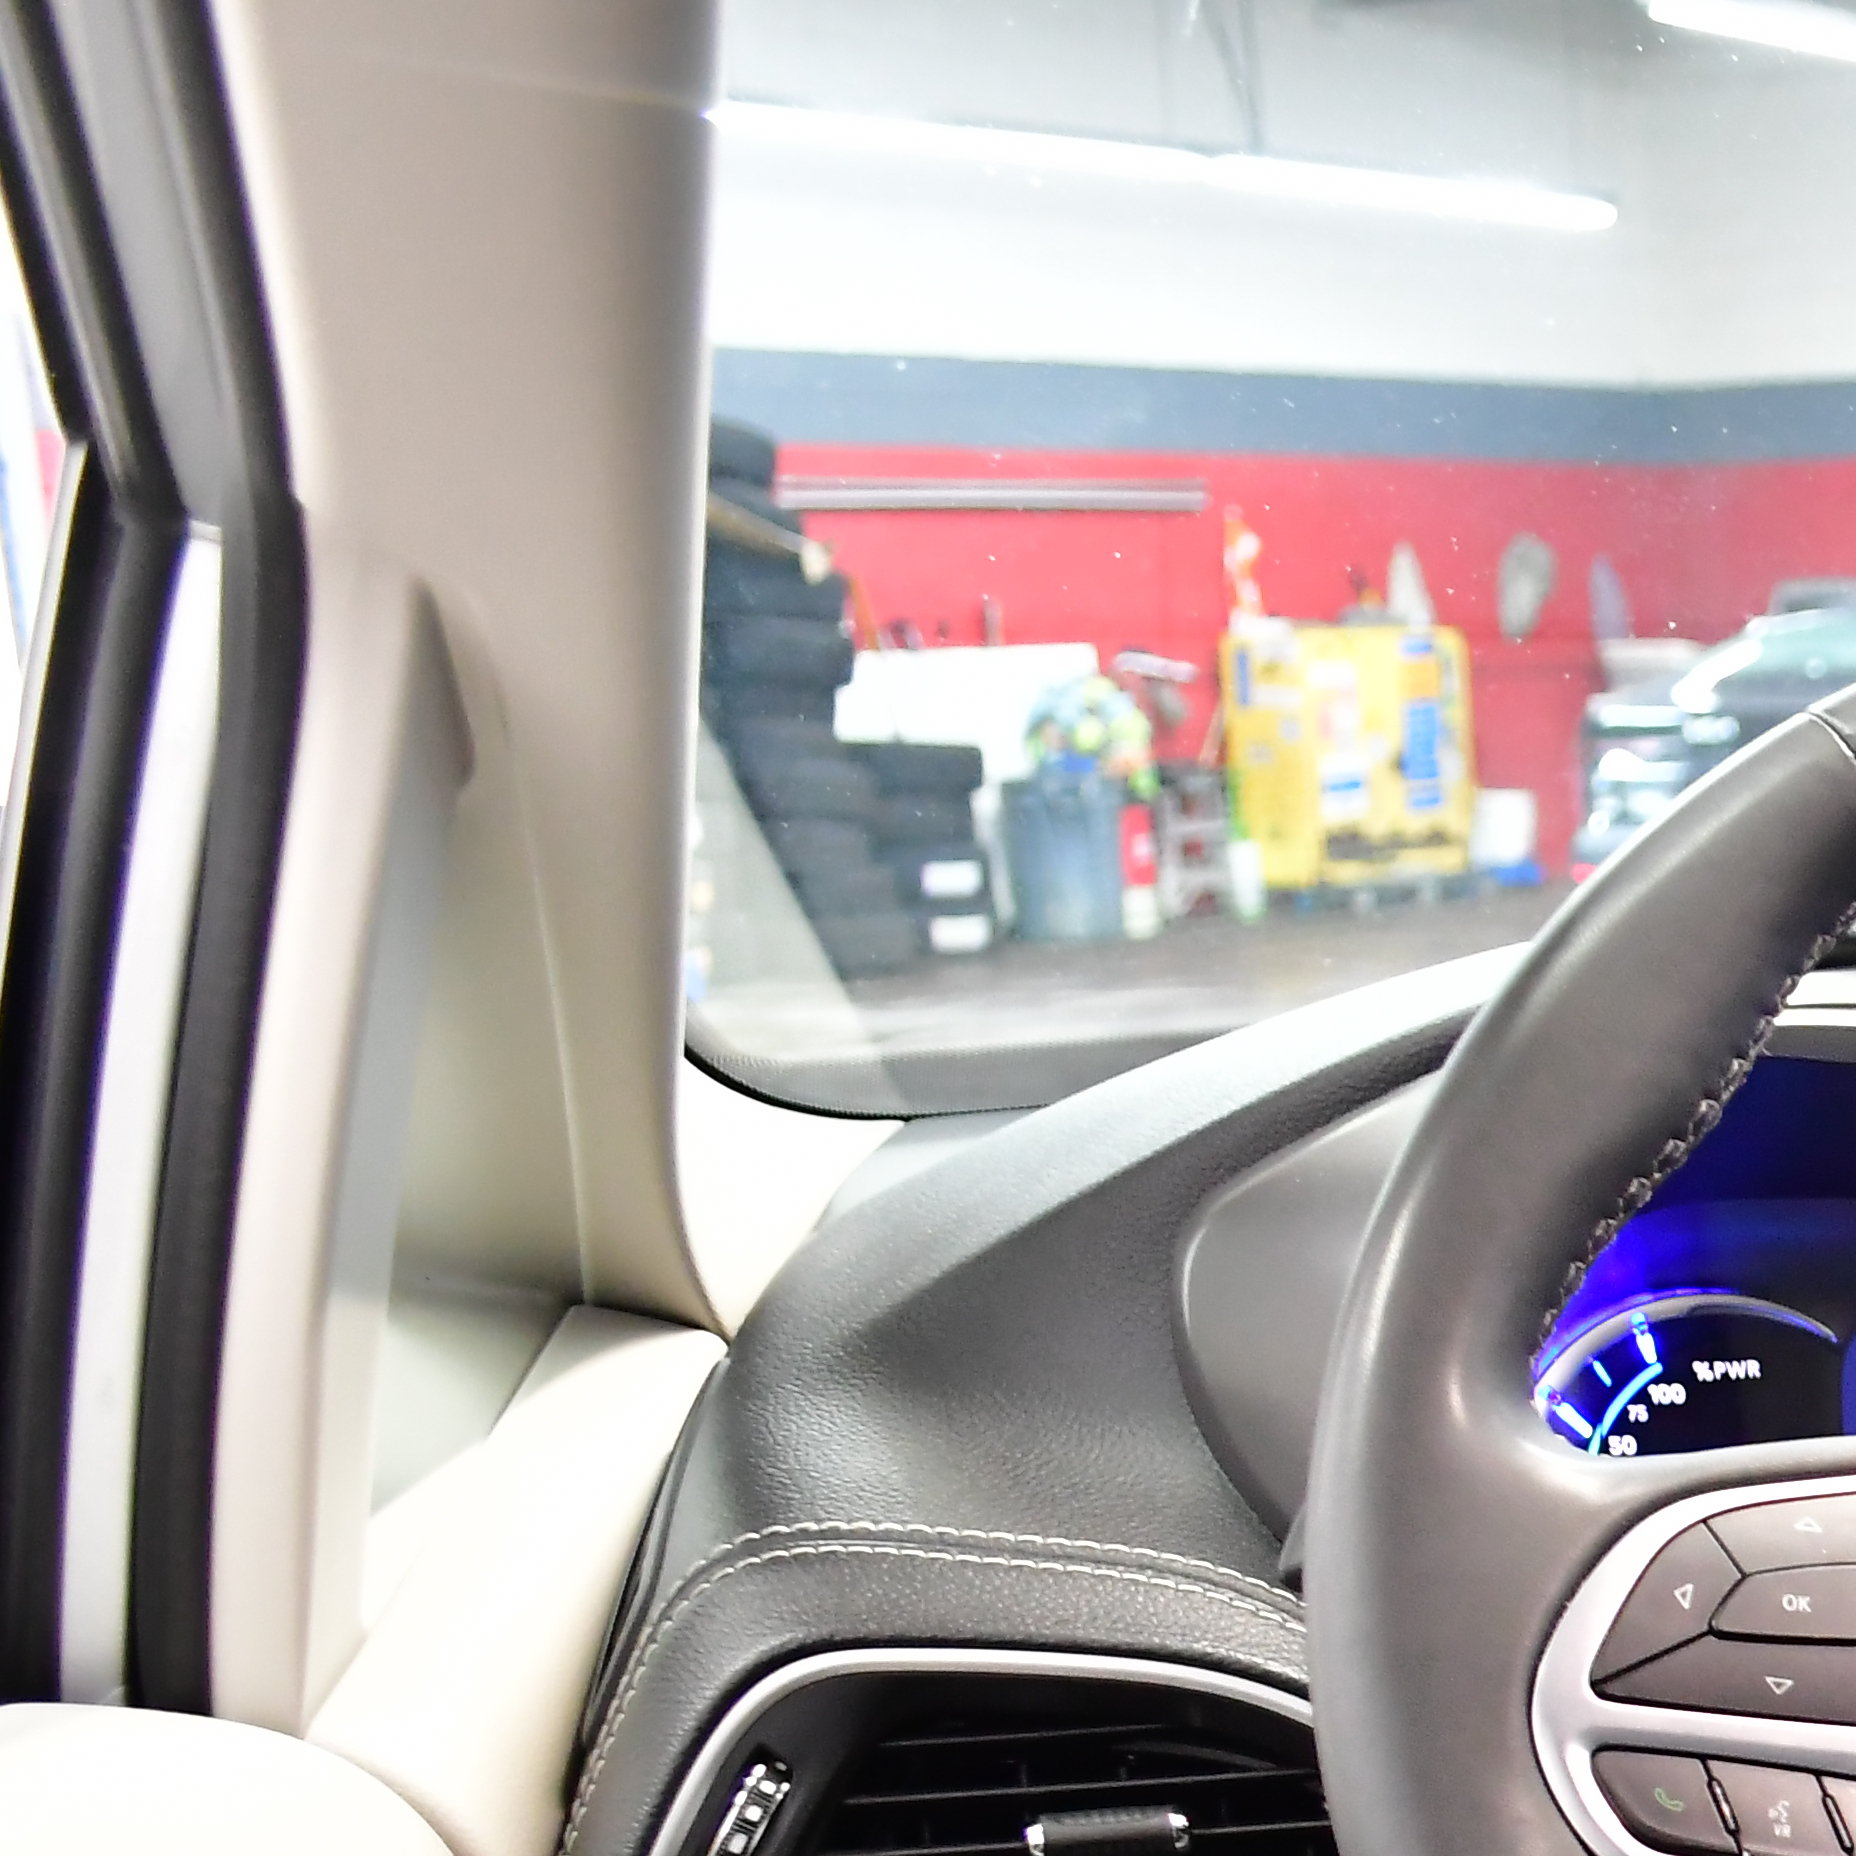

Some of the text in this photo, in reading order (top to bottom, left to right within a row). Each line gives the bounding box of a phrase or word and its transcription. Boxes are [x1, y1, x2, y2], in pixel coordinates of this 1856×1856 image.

[1647, 1383, 1687, 1405] 100
[1627, 1404, 1649, 1423] 75
[1608, 1435, 1638, 1456] 50
[1782, 1594, 1811, 1612] OK
